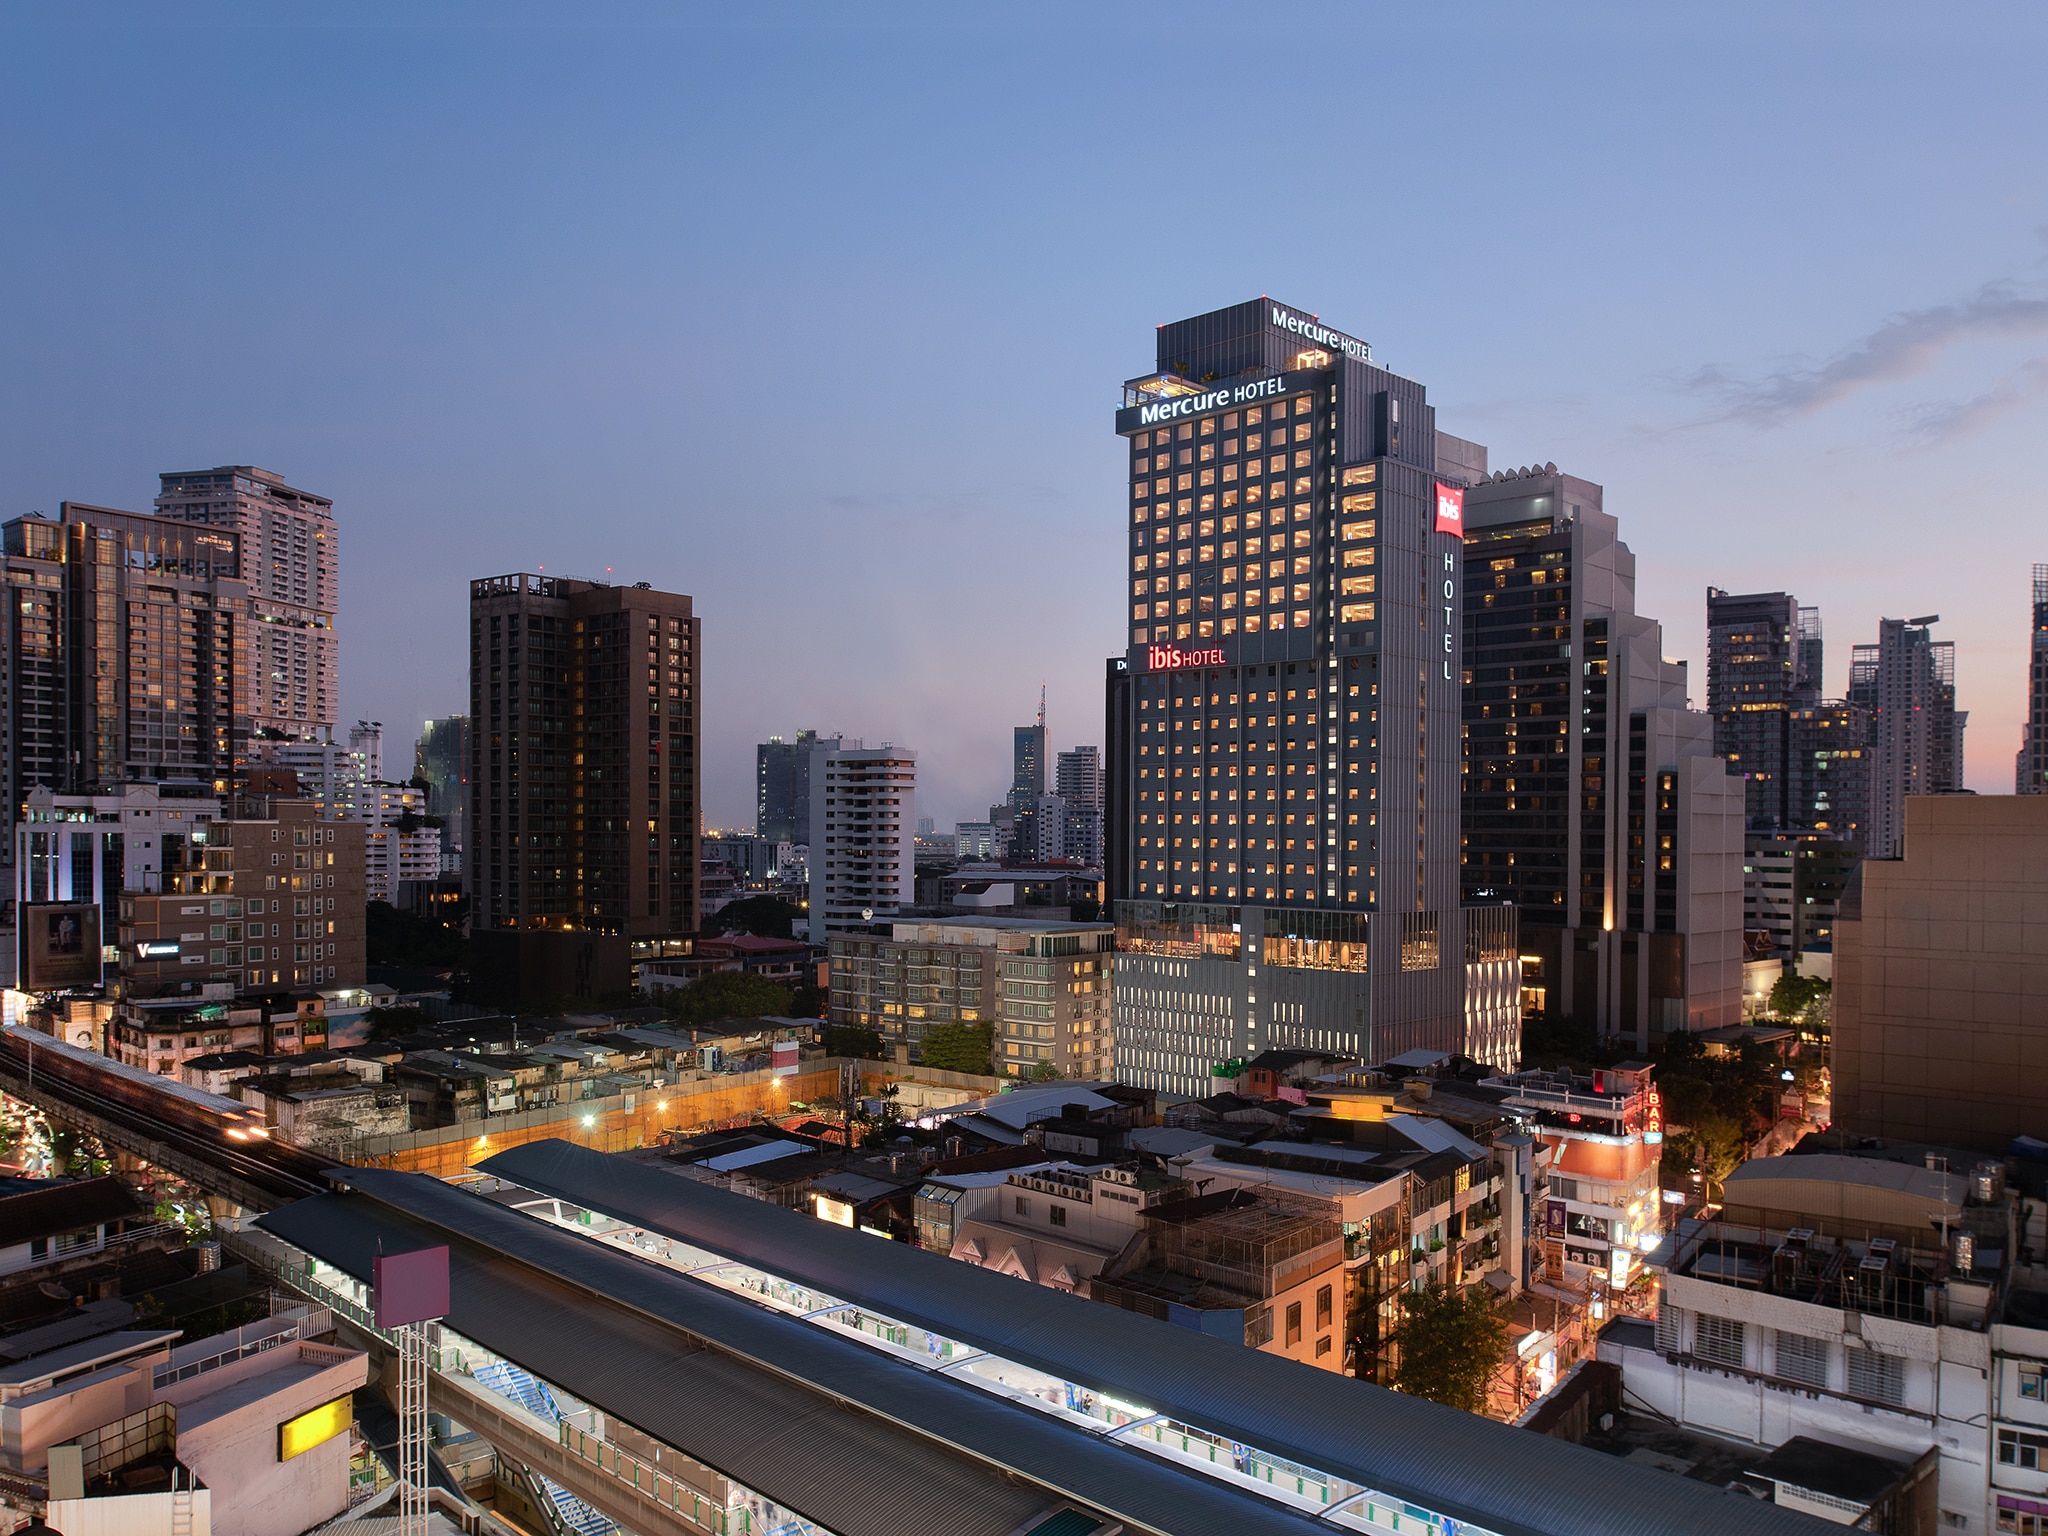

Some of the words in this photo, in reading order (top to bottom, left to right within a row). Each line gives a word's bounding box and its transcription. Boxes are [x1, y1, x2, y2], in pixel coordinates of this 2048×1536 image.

[1272, 307, 1339, 348] Mercure
[1340, 337, 1373, 361] HOTEL
[1141, 389, 1230, 425] Mercure
[1234, 376, 1286, 403] HOTEL
[1439, 495, 1459, 520] ibis
[1444, 552, 1454, 680] HOTEL
[1149, 644, 1182, 670] ibis
[1183, 649, 1226, 667] HOTEL
[1649, 1093, 1660, 1132] BAR
